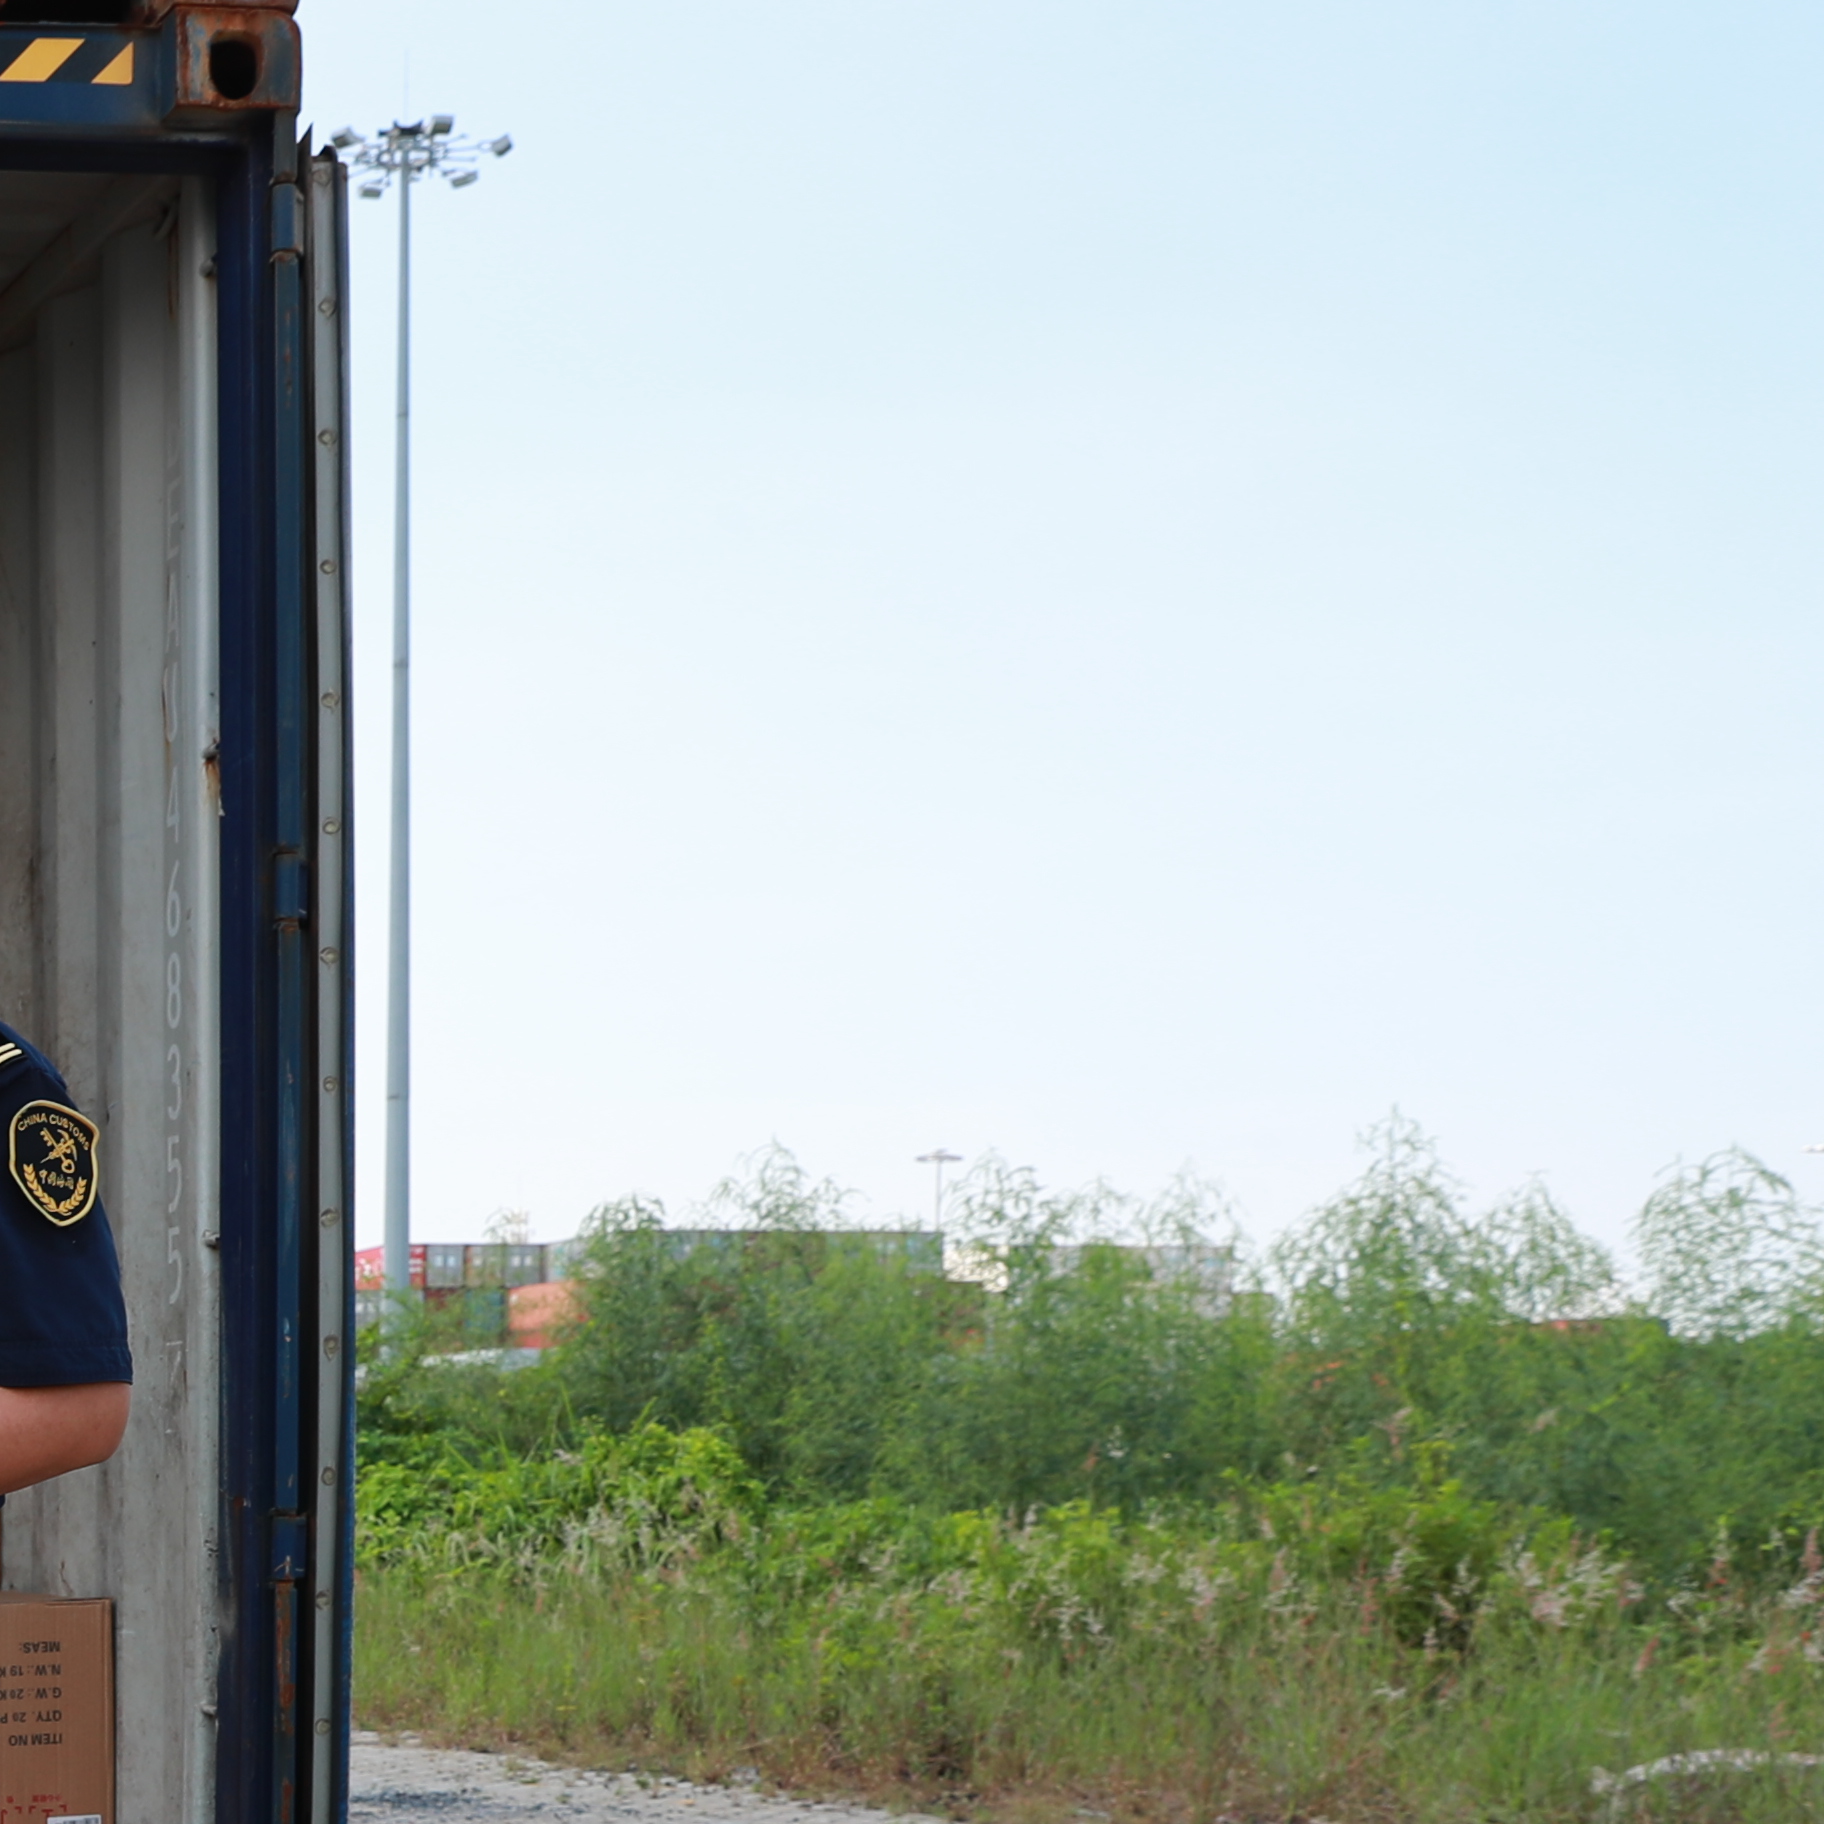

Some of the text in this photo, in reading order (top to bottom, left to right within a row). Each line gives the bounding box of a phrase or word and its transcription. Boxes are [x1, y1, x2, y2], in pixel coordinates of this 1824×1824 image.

[17, 1112, 90, 1151] CHINA CUSTOMS
[31, 1733, 63, 1746] ITEM
